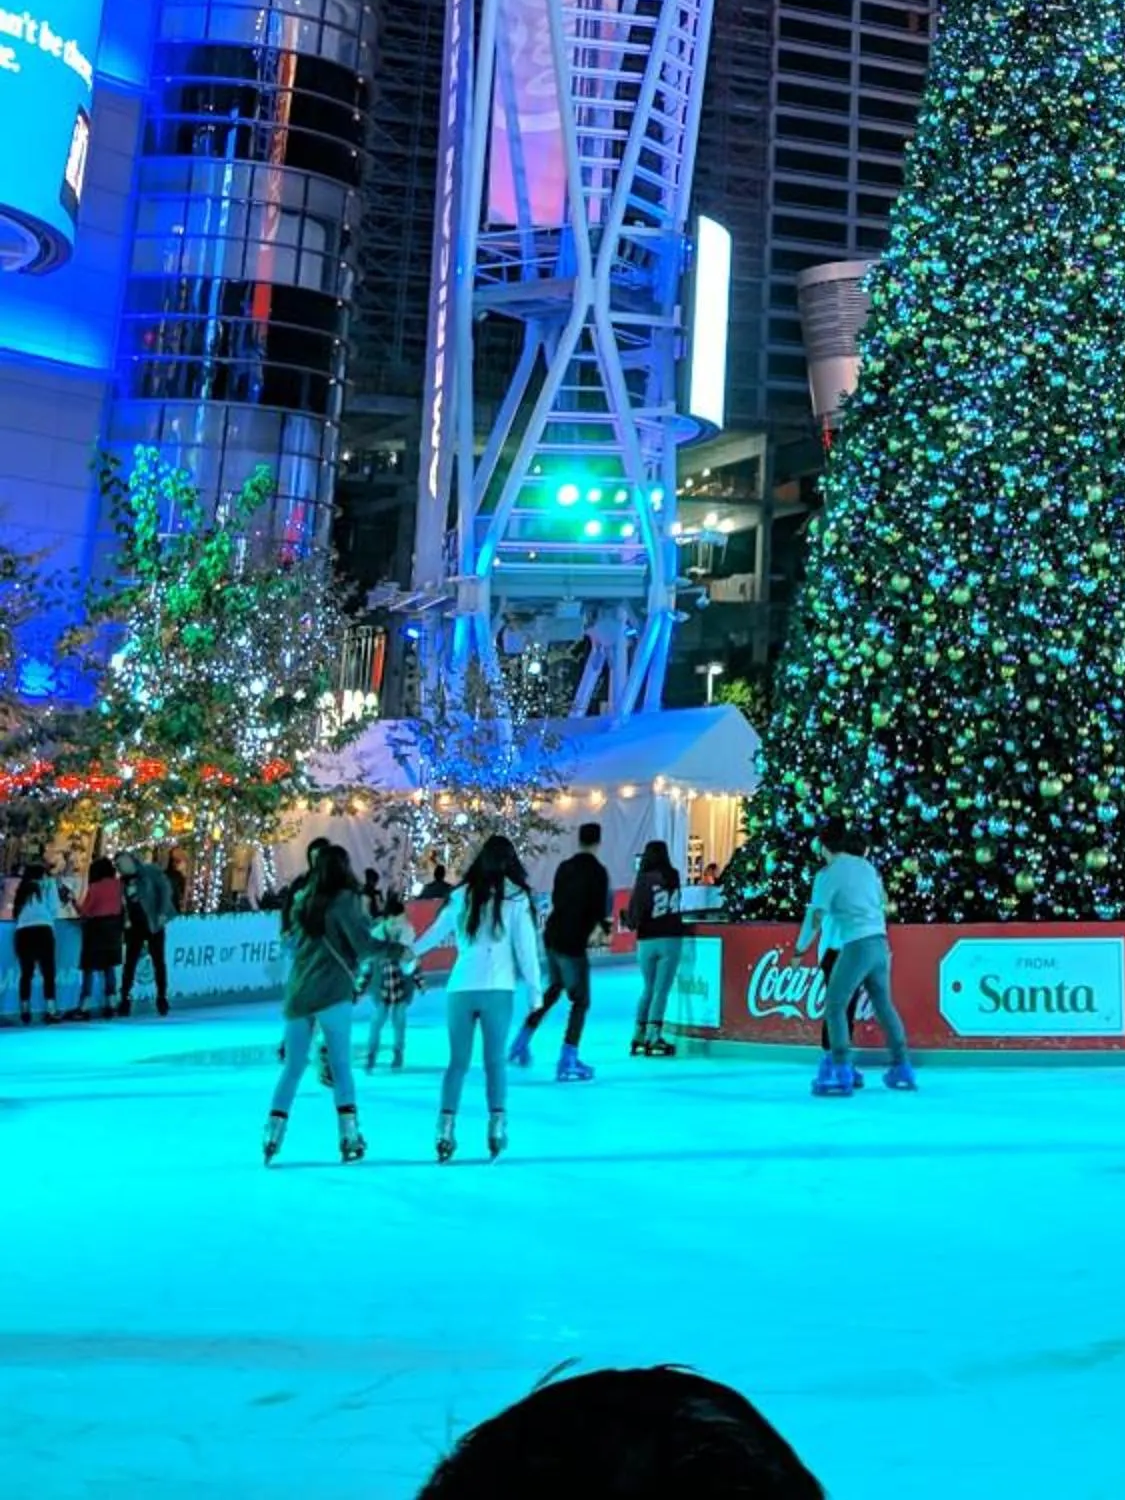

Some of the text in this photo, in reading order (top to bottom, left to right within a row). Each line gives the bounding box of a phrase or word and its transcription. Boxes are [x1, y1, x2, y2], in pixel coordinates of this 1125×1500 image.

[429, 146, 454, 499] AMERICAN
[173, 945, 215, 968] PAIR
[240, 940, 281, 964] THIE
[977, 974, 1100, 1014] Santa
